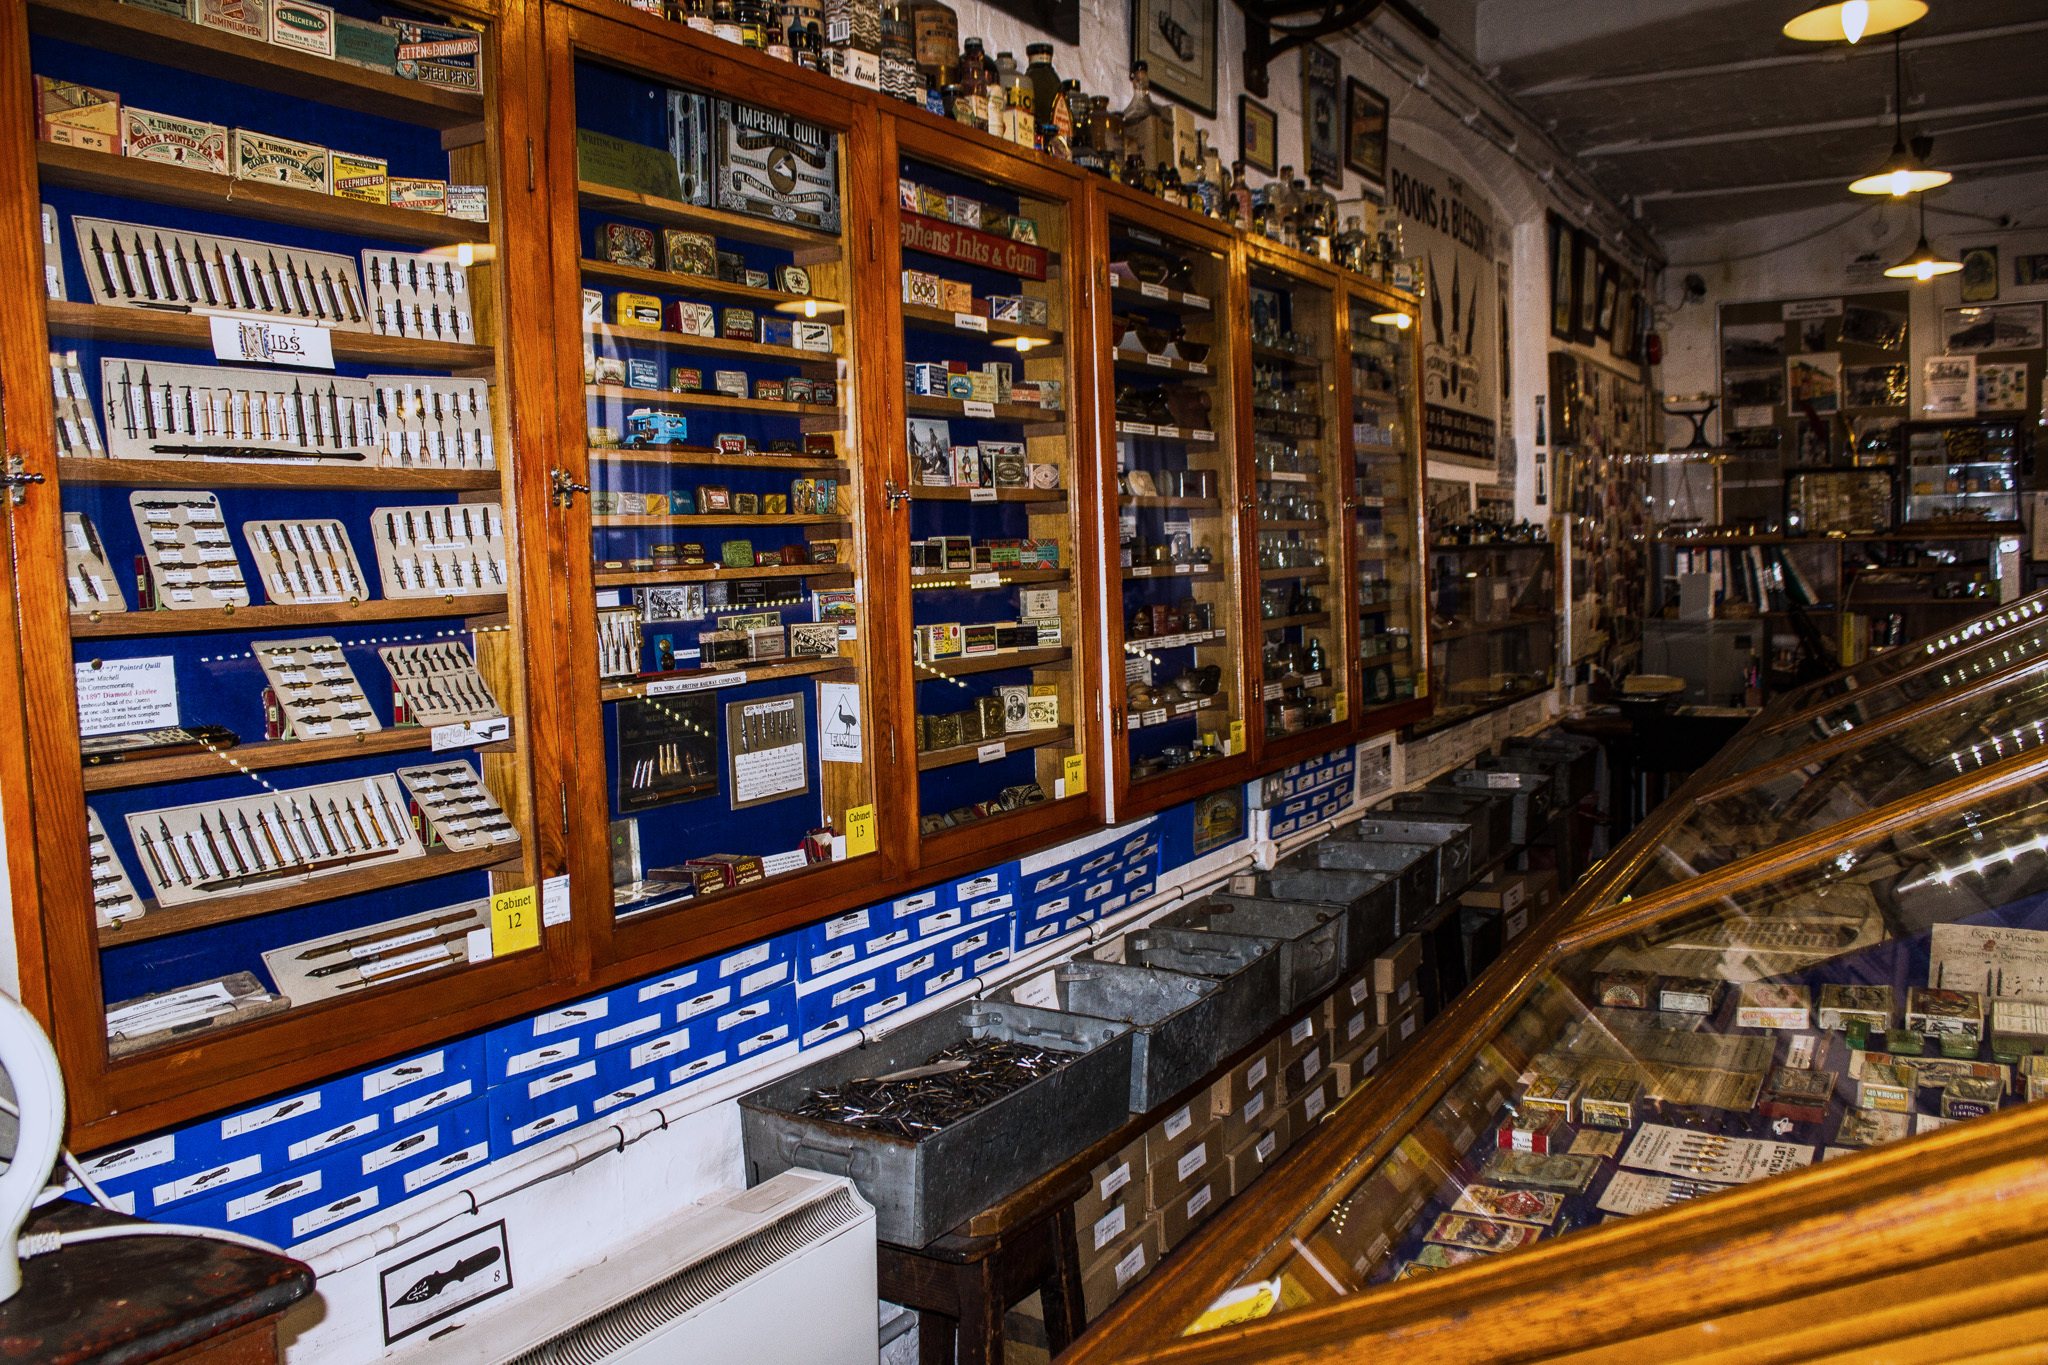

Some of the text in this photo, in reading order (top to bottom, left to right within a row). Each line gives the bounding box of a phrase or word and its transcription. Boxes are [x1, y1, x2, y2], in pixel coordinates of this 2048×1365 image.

[203, 13, 263, 38] ALUMINIUM PEN
[420, 65, 477, 87] STEEL PENS
[854, 66, 877, 84] Quink
[738, 105, 790, 138] IMPERIAL
[53, 135, 71, 144] GROSS
[137, 134, 162, 150] GLOBE
[163, 133, 197, 149] POINTED
[247, 155, 269, 170] GLOBE
[270, 154, 300, 169] POINTED
[337, 175, 385, 189] TELEPHONE PEN
[733, 172, 746, 182] THE
[746, 174, 773, 197] COMPLETE
[396, 182, 442, 197] Brief Quill Pen
[341, 191, 381, 203] PERFECTION
[1441, 198, 1449, 234] &
[955, 230, 990, 265] Inks
[991, 247, 1003, 266] &
[1006, 245, 1037, 275] Gum
[726, 329, 753, 338] BEST PENS
[238, 321, 301, 362] NIBS
[814, 642, 829, 653] PEN
[119, 662, 162, 672] Pointed Quill
[88, 682, 135, 692] Commemorating
[699, 680, 718, 688] RAILWAY
[718, 676, 742, 686] COMPANIES
[85, 688, 158, 701] 1897 Diamond Jubilee
[106, 699, 119, 707] head
[154, 702, 173, 711] ground
[102, 714, 127, 722] decorated
[138, 711, 161, 720] complete
[1066, 759, 1082, 769] Cabinet
[1071, 771, 1078, 782] 14
[849, 811, 872, 823] Cabinet
[855, 825, 865, 838] 13
[738, 861, 756, 872] GROSS
[703, 869, 720, 880] GROSS
[496, 895, 532, 912] Cabinet
[508, 912, 523, 930] 12
[1959, 1104, 1985, 1114] GROSS
[494, 1269, 501, 1283] 8
